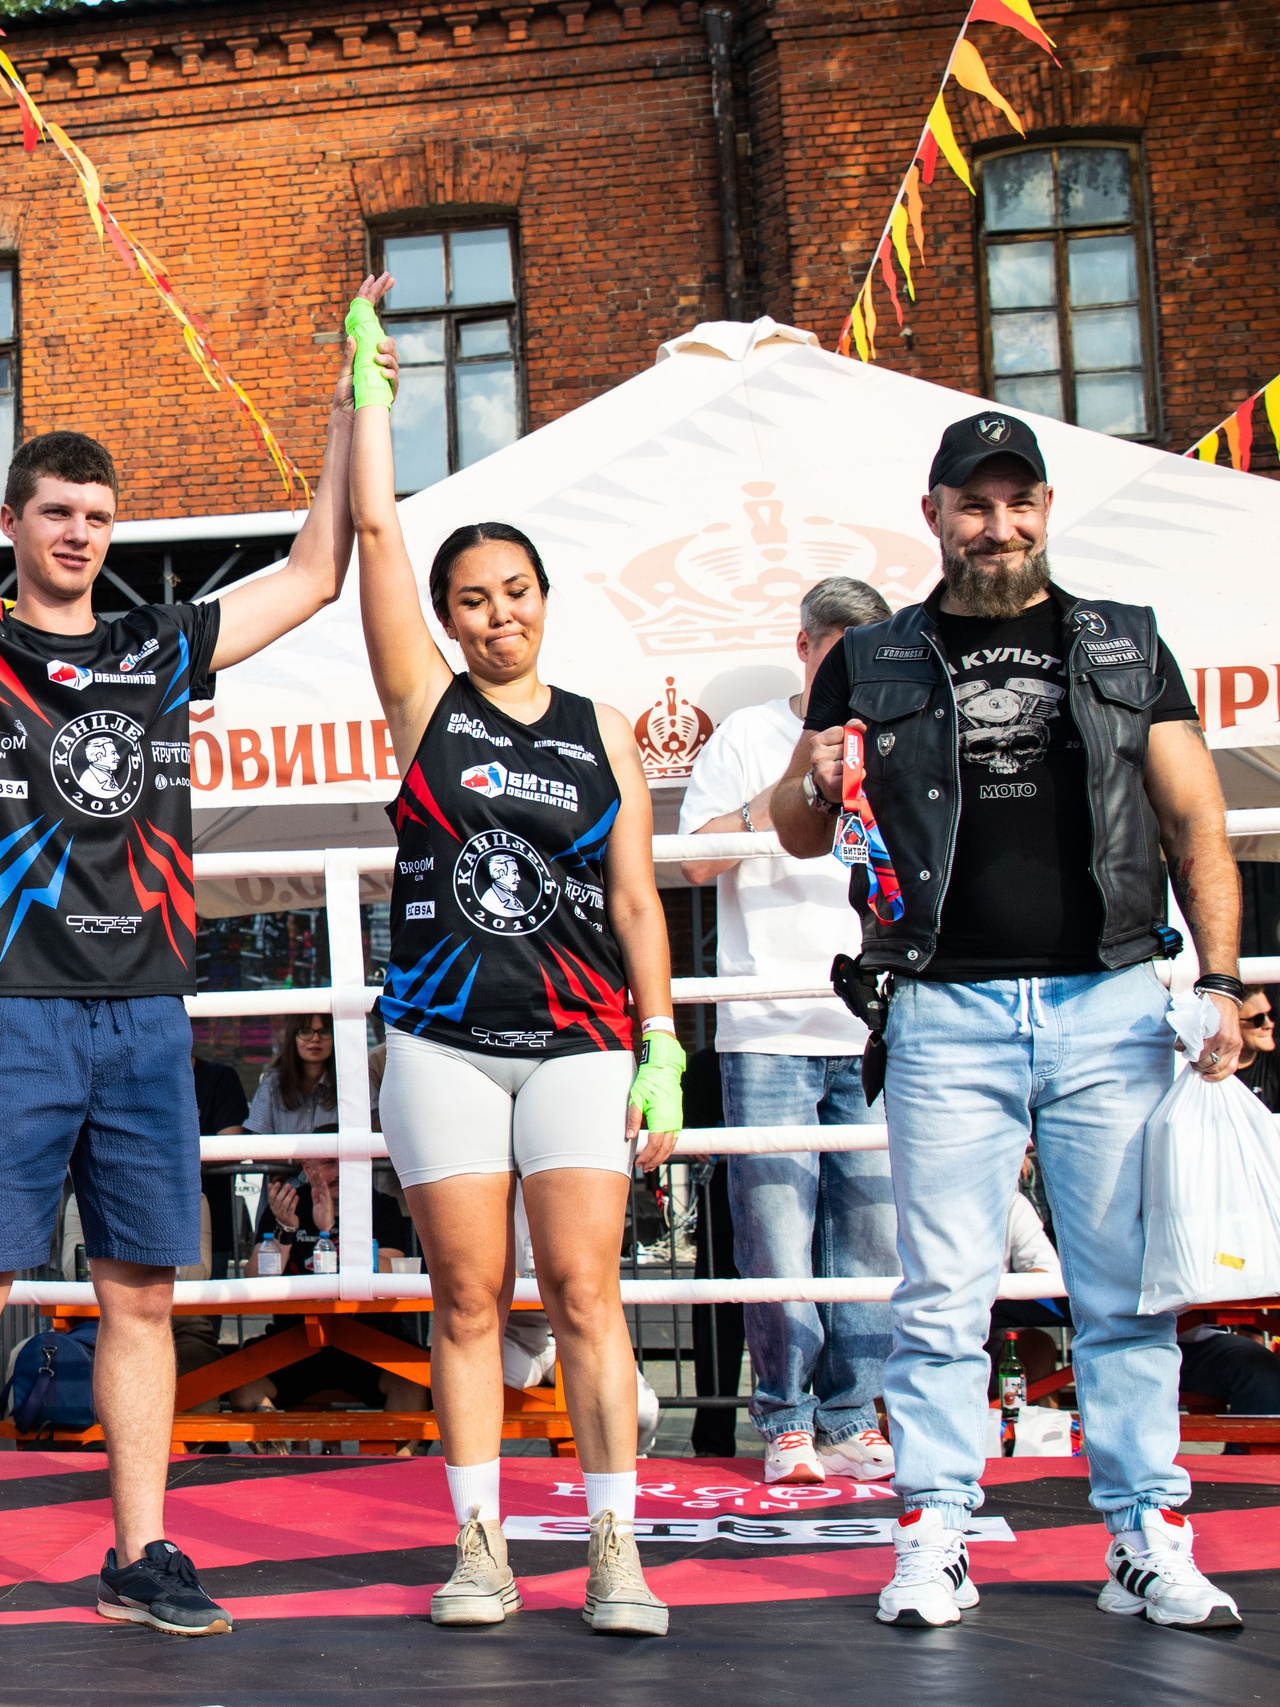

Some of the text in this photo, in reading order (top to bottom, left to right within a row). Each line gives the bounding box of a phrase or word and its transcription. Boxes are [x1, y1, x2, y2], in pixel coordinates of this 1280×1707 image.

[961, 647, 1062, 670] КУЛЬТ
[94, 672, 157, 685] ОБЩЕПИТОВ
[55, 714, 142, 770] КАНЦЛЕЪ
[447, 722, 513, 747] ЕРМОЛИНА
[507, 771, 578, 802] БИТВА
[72, 791, 132, 812] 2010
[506, 786, 578, 812] ОБЩЕПИТОВ
[399, 857, 434, 874] BROOM
[474, 909, 536, 930] 2010
[682, 1497, 799, 1509] GIN
